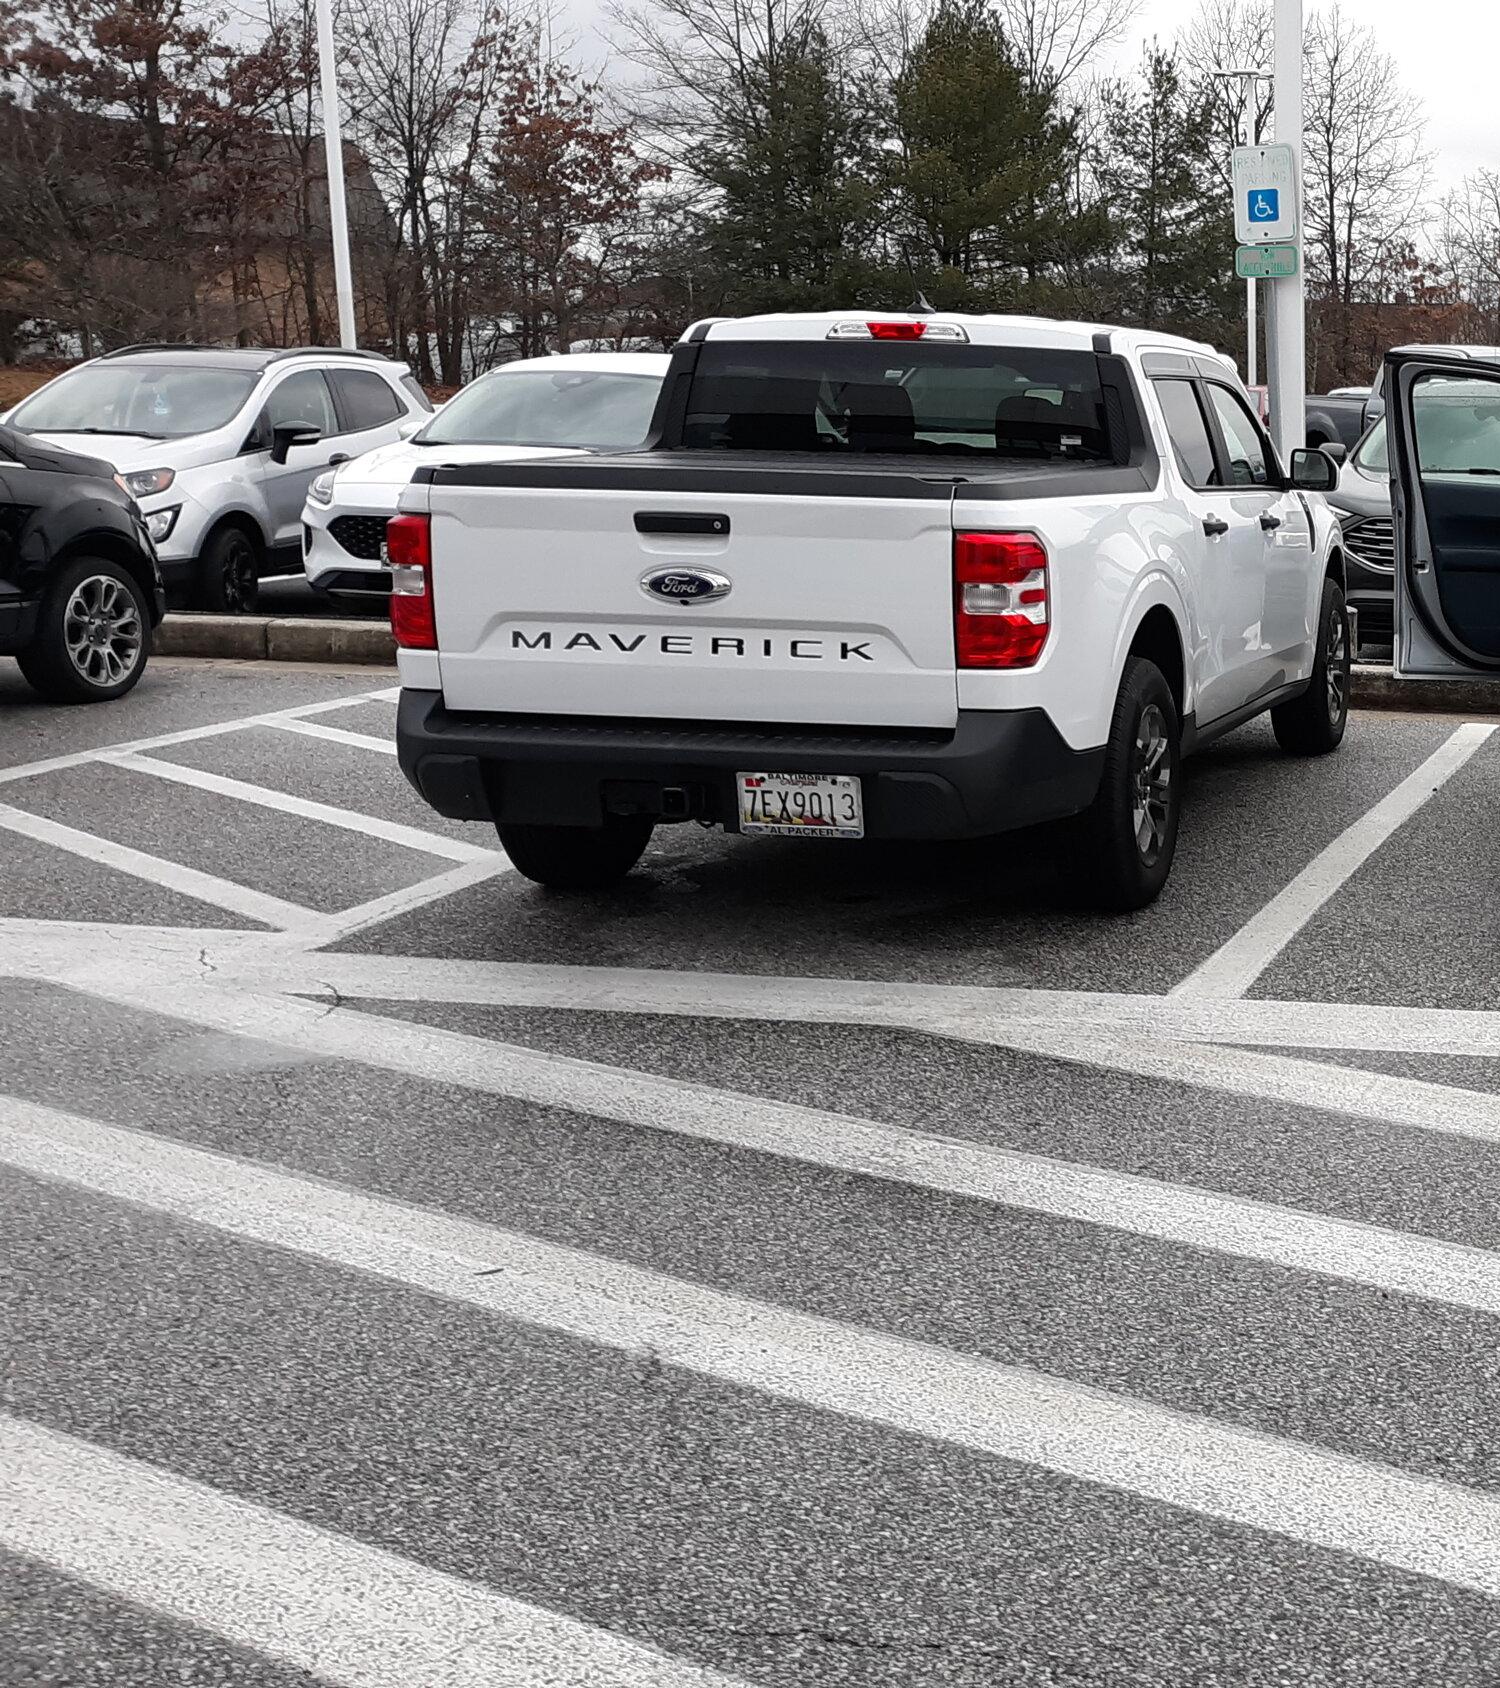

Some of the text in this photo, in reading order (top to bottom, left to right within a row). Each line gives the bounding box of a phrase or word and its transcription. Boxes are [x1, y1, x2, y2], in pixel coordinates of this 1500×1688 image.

[1236, 154, 1289, 169] RESVED
[661, 576, 700, 594] Ford
[511, 630, 875, 661] MAVERICK
[768, 773, 829, 782] BALTIMORE
[744, 789, 856, 826] 7EX9013
[769, 826, 784, 834] AL
[787, 827, 835, 837] PACKER
